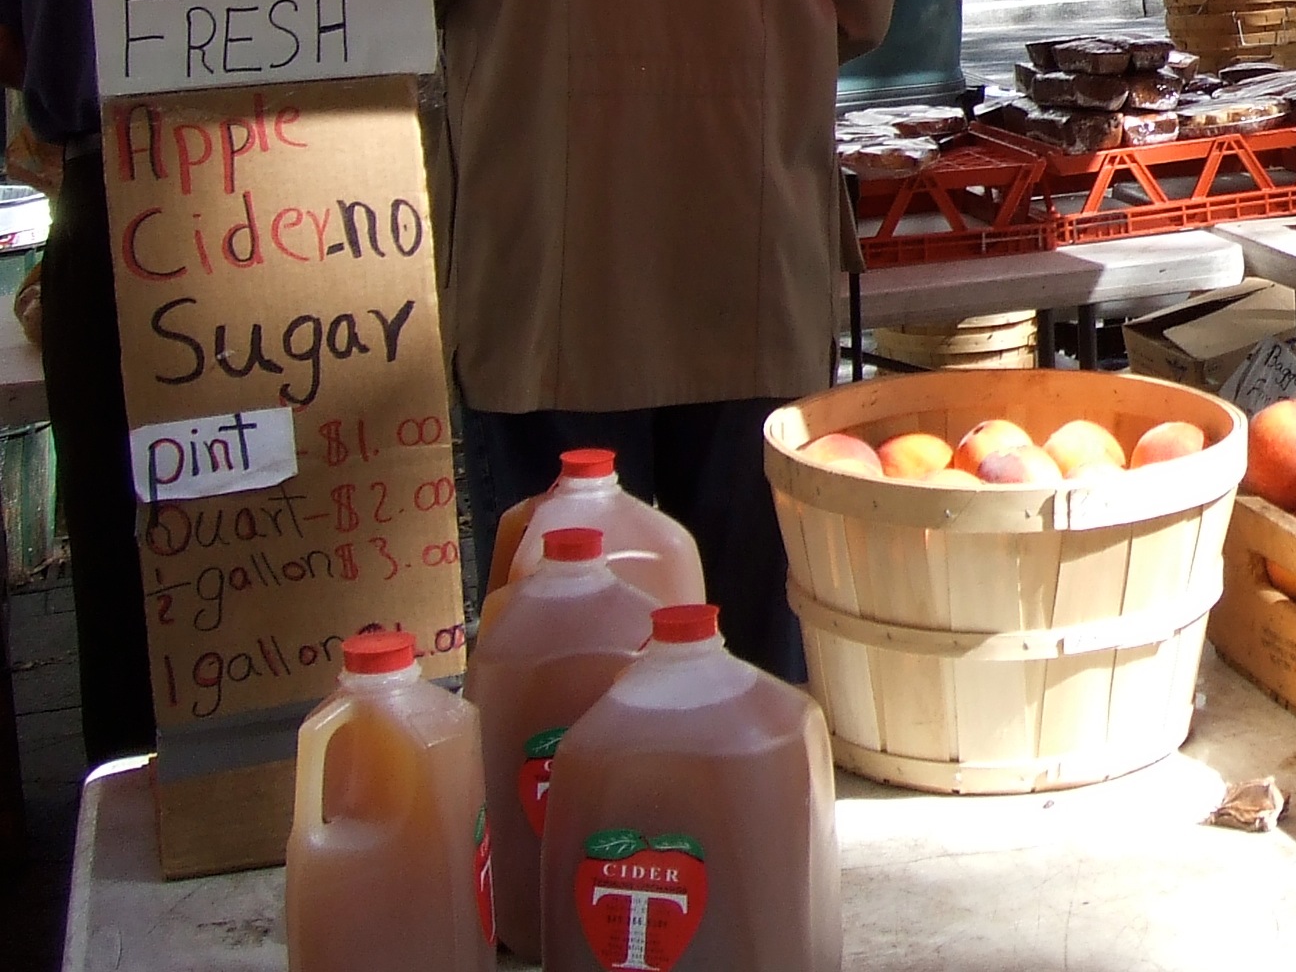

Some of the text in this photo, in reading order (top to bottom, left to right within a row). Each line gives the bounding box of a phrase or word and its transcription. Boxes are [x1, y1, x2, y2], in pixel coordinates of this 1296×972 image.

[115, 93, 308, 195] Apple
[151, 297, 416, 406] Sugar
[147, 413, 257, 502] pint
[602, 862, 679, 883] CIDER
[592, 886, 689, 972] T
